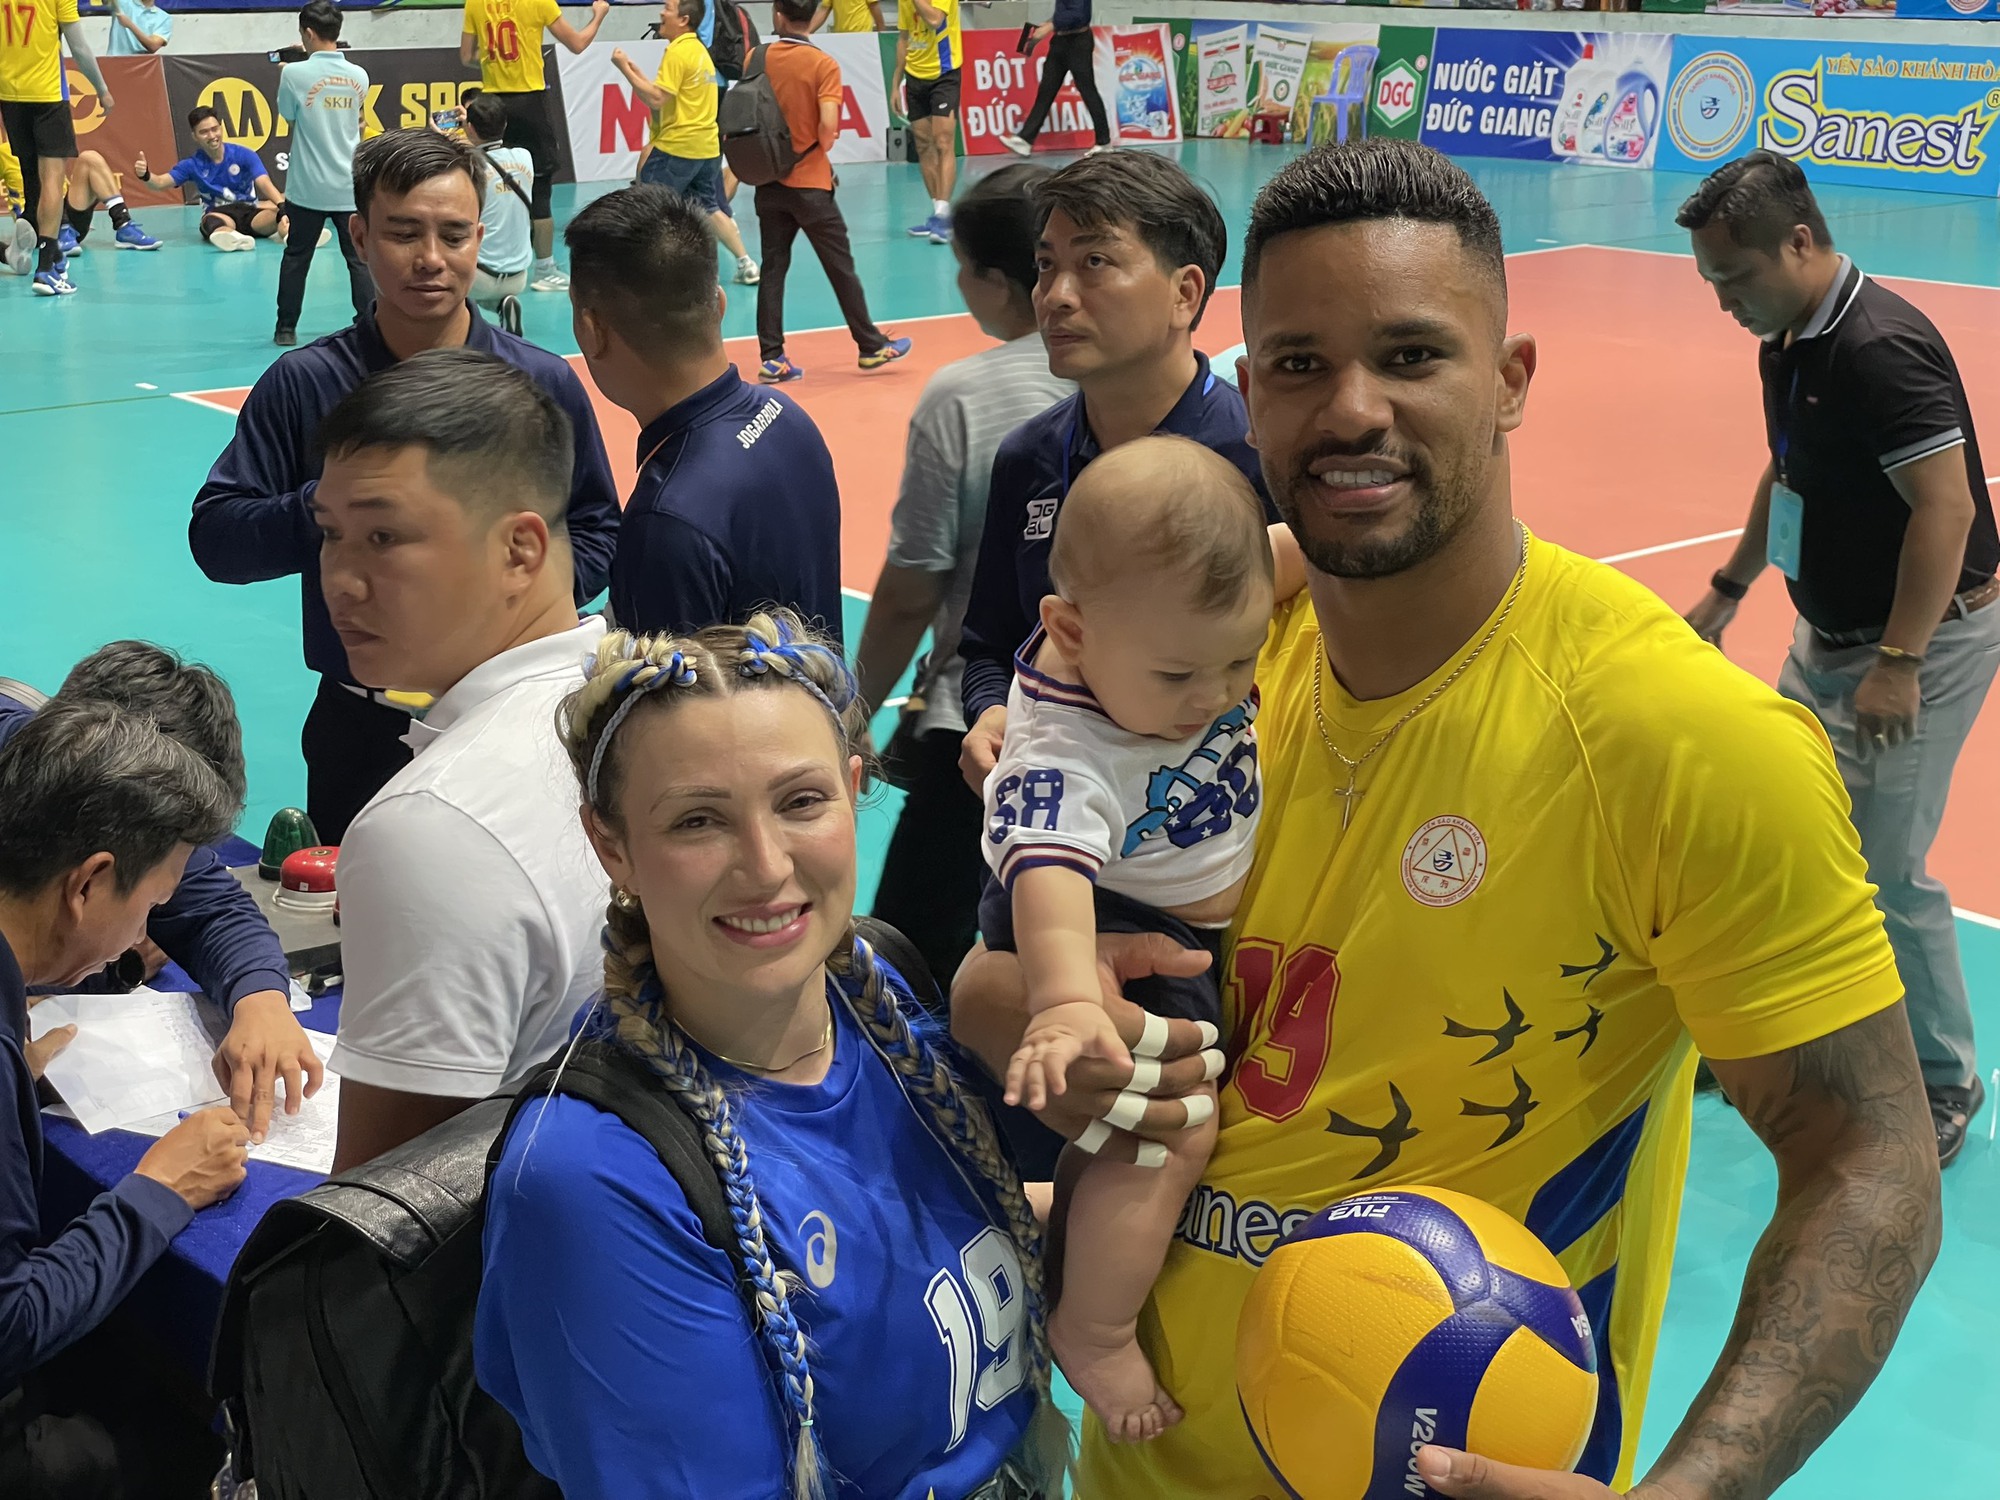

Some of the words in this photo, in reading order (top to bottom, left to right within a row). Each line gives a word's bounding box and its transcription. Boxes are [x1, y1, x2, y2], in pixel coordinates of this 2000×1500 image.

[3, 5, 36, 47] 17
[485, 19, 521, 62] 10
[974, 51, 1026, 97] BỘT
[1433, 57, 1498, 93] NƯỚC
[1503, 60, 1559, 101] GIẶT
[1827, 52, 1860, 75] YẾN
[1863, 55, 1898, 77] SÀO
[1901, 58, 1965, 80] KHÁNH
[323, 96, 354, 109] SKH
[1379, 80, 1415, 107] DGC
[967, 97, 1025, 137] ĐỨC
[1426, 97, 1474, 133] ĐỨC
[1480, 105, 1552, 137] GIANG
[1761, 69, 1990, 171] Sanest
[736, 397, 784, 449] JOGARBOLA
[1218, 936, 1342, 1124] 19
[924, 1225, 1030, 1453] 19
